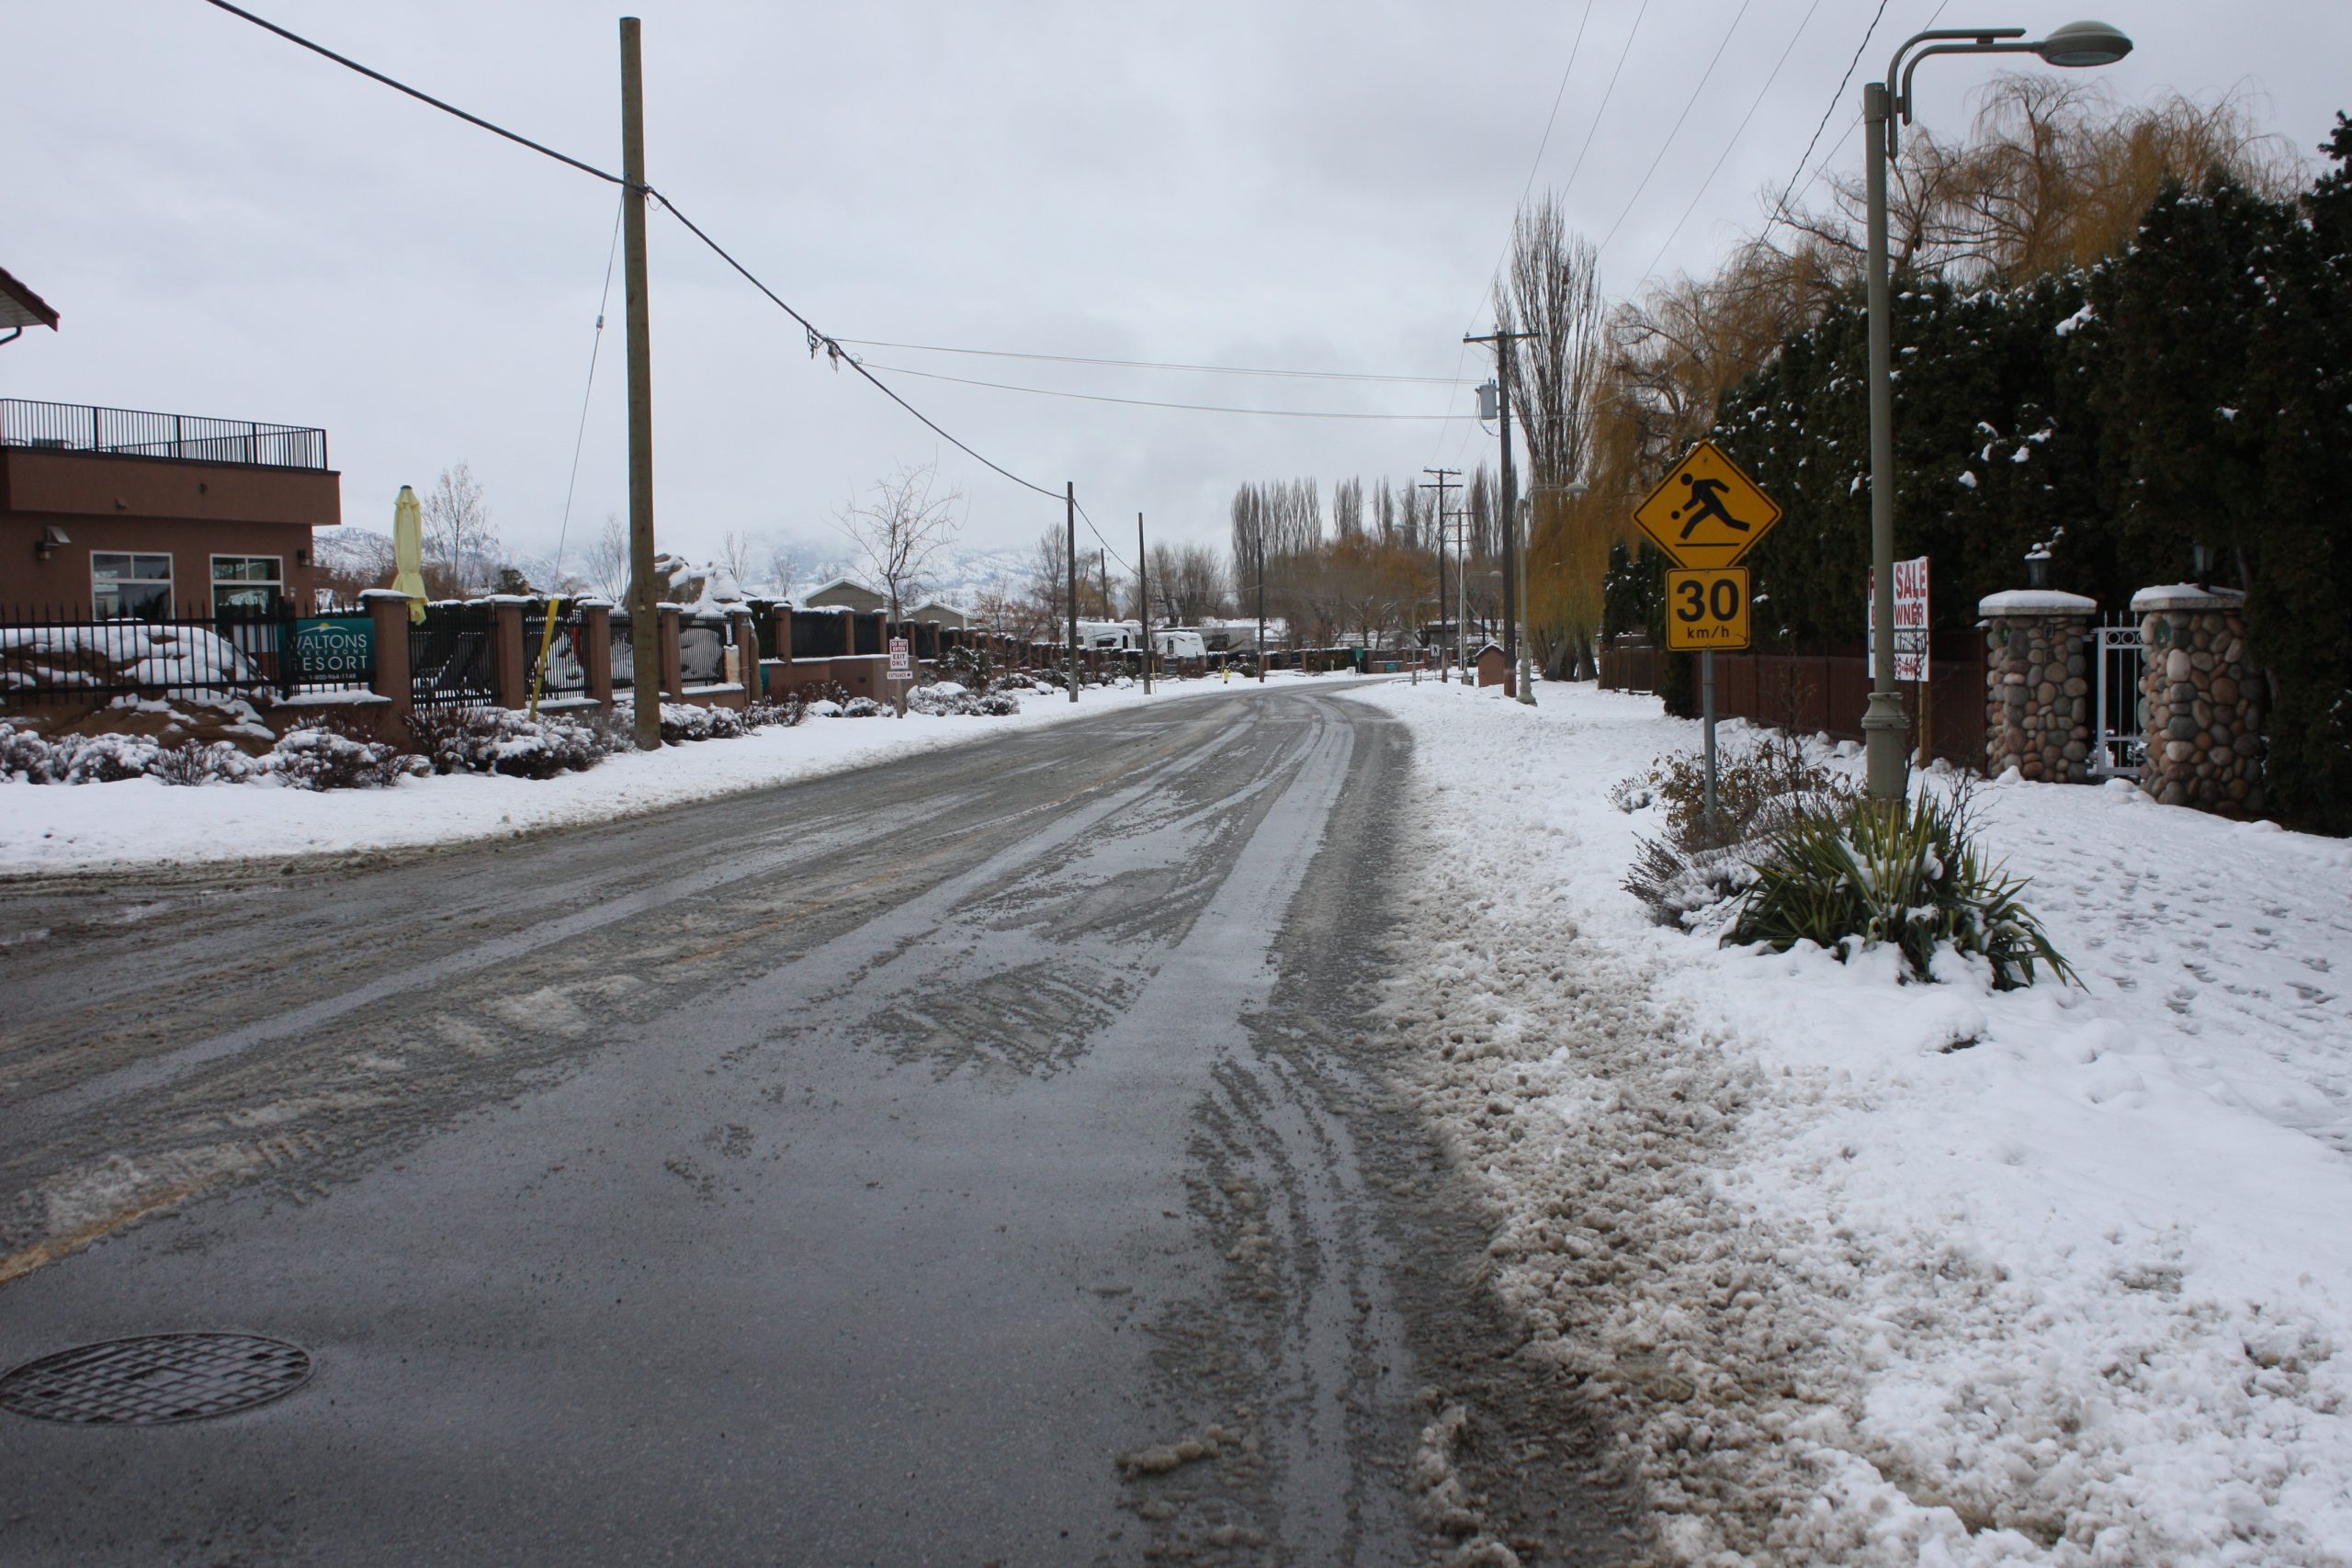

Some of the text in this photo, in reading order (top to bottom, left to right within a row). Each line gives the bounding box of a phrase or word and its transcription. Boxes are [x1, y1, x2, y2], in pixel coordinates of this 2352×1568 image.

[1895, 562, 1927, 600] SALE
[1677, 579, 1739, 622] 30
[1894, 603, 1924, 626] WNER
[1687, 626, 1729, 639] km/h
